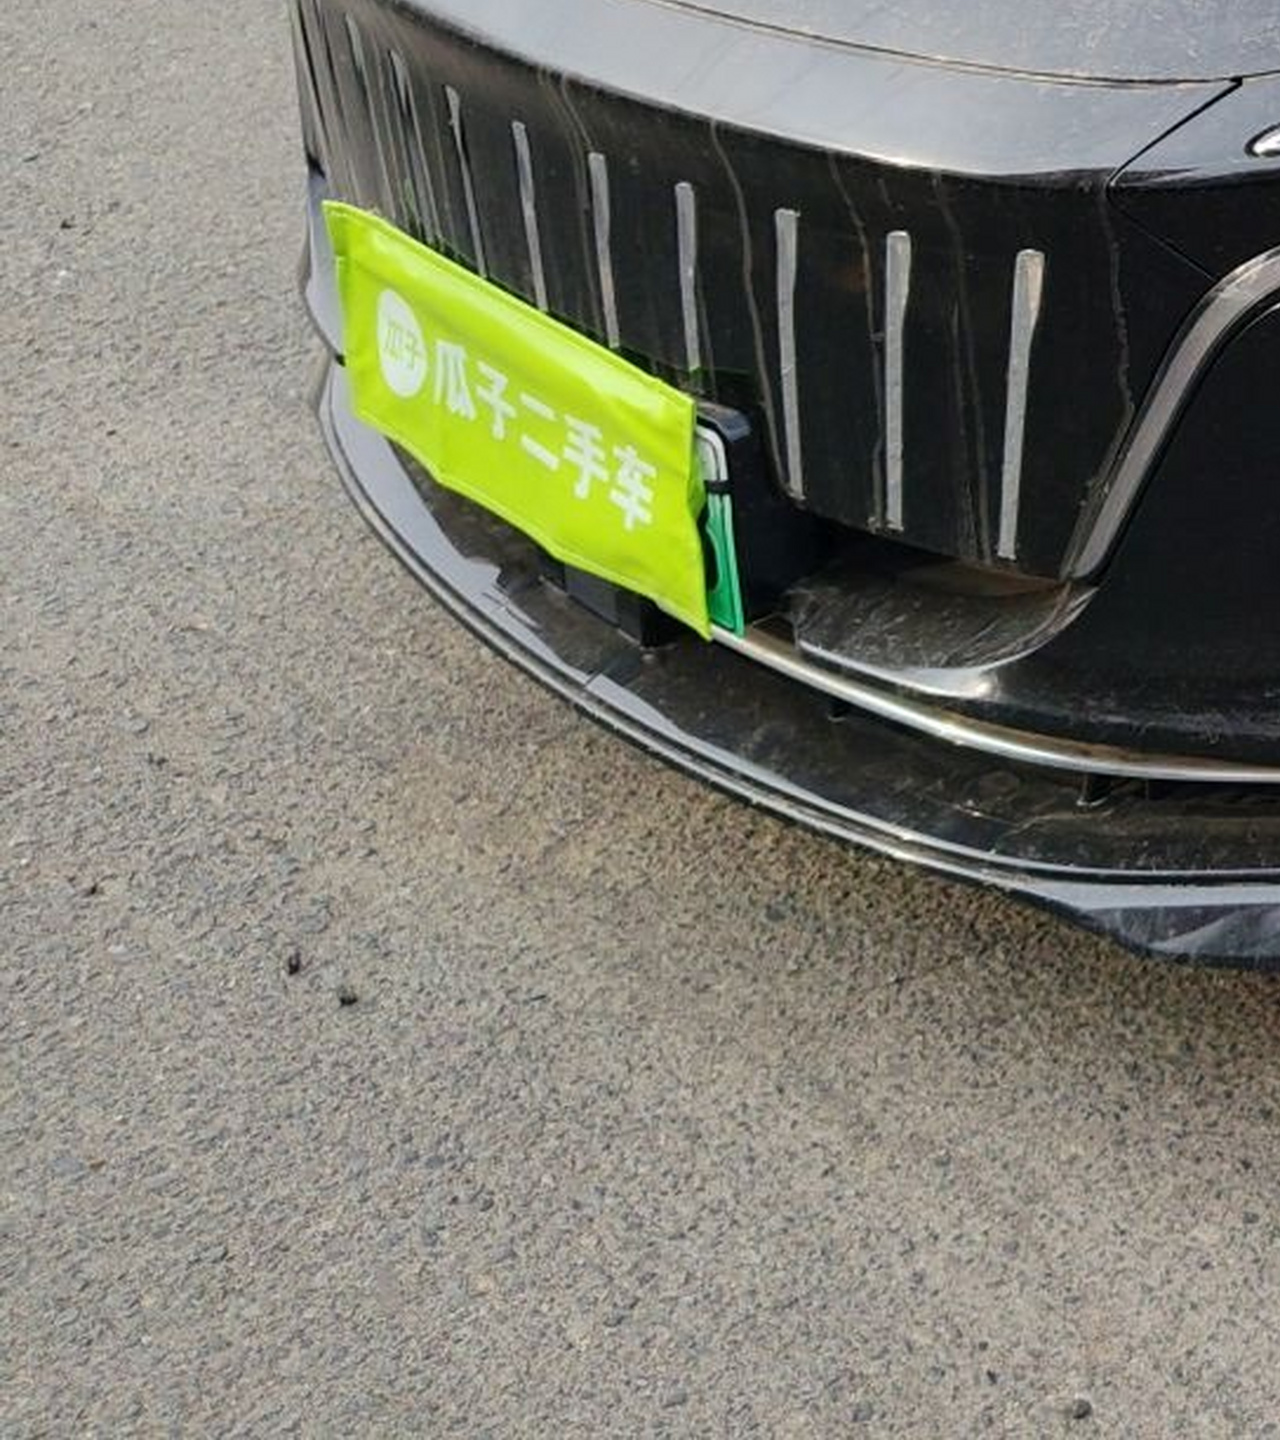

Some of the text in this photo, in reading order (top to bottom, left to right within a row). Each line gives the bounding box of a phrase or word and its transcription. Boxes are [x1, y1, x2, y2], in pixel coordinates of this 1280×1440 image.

[433, 339, 657, 531] 瓜子二手车
